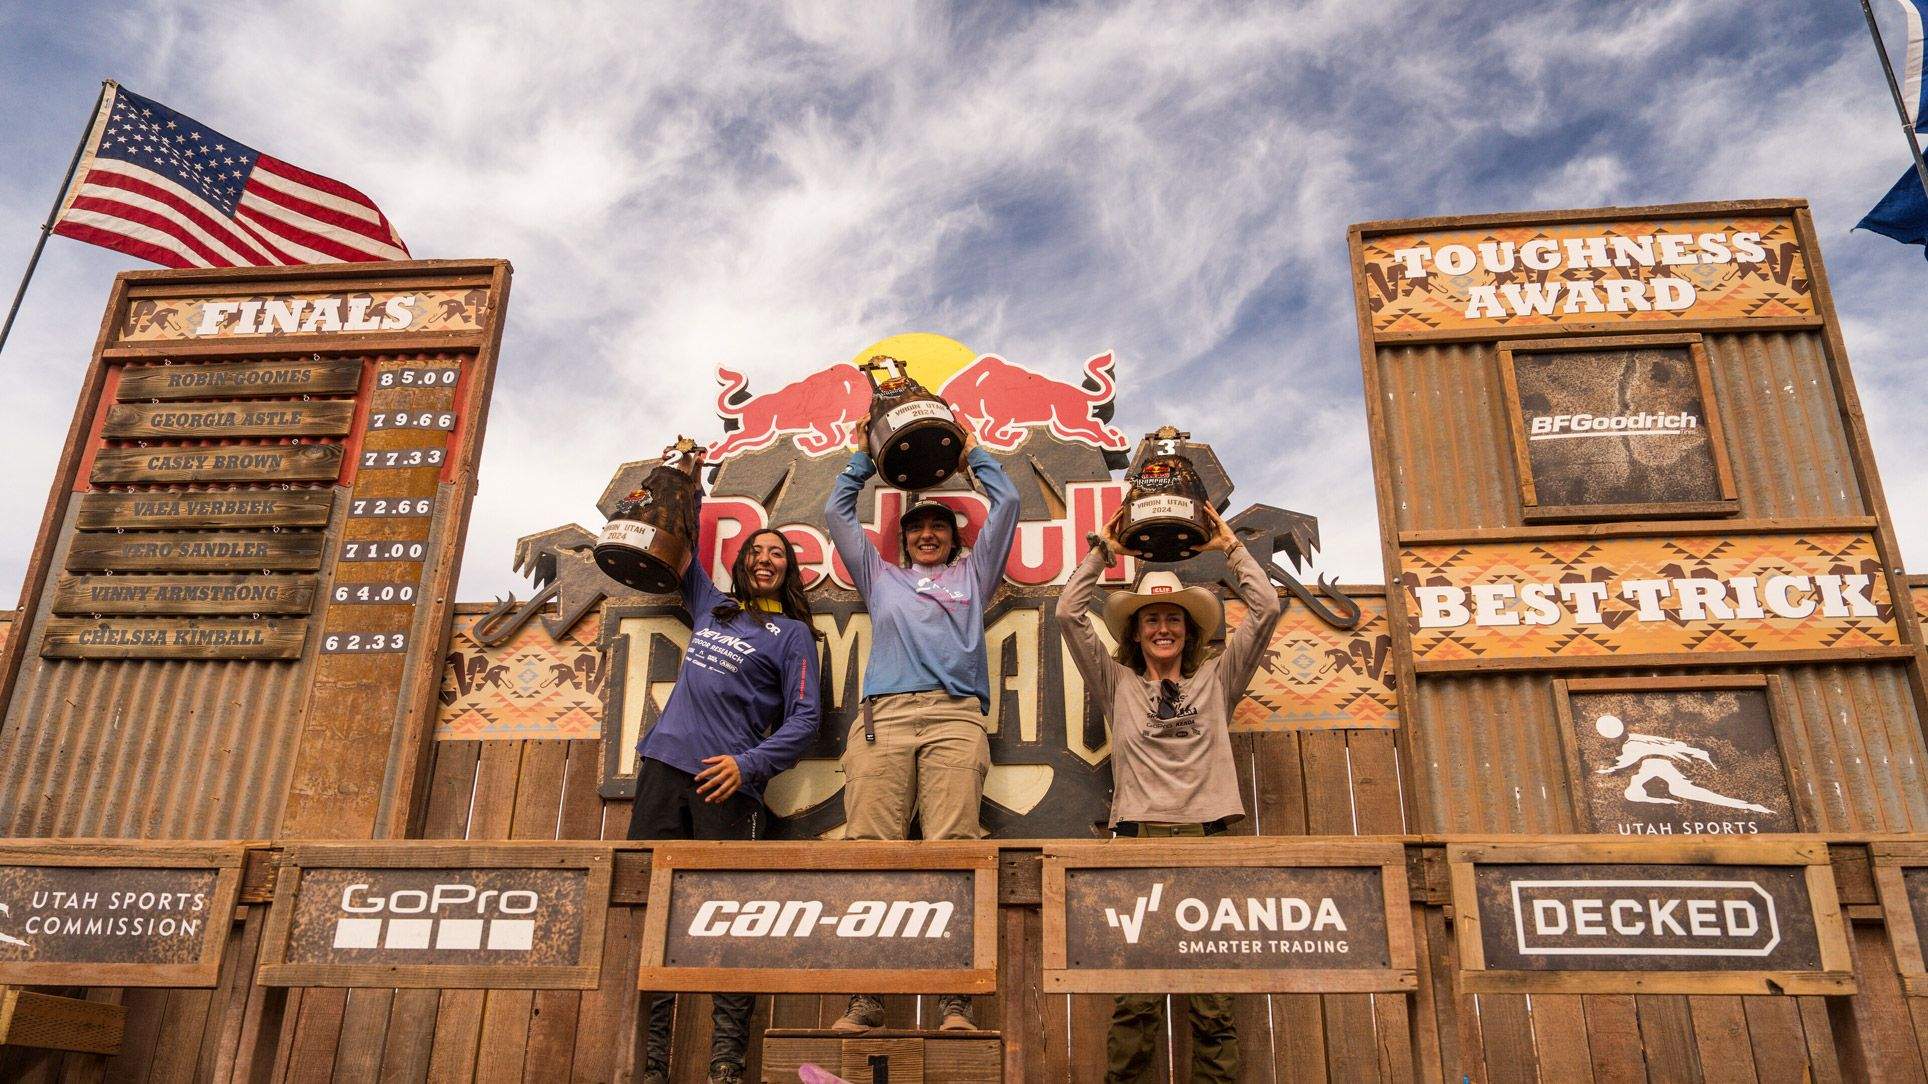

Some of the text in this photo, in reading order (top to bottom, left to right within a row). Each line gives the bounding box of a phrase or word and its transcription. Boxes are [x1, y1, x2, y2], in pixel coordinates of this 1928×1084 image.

[1394, 231, 1767, 280] TOUGHNESS
[1464, 276, 1697, 319] AWARD
[196, 295, 415, 335] FINALS
[168, 369, 311, 387] ROBIN GOOMES
[380, 371, 455, 386] 85.00
[151, 411, 302, 428] GEORGIA ASTLE
[374, 413, 451, 428] 79.66
[1531, 411, 1698, 434] BFGoodrich
[1157, 439, 1176, 455] 3
[148, 454, 283, 471] CASEY BROWN
[365, 450, 441, 466] 77.33
[663, 450, 684, 466] 2
[354, 500, 429, 515] 72.66
[1137, 499, 1188, 509] VIRGIN UTAH
[625, 524, 645, 534] UTAH
[122, 542, 268, 558] VERO SANDLER
[346, 543, 422, 558] 71.00
[91, 585, 278, 601] VINNY ARMSTRONG
[335, 586, 413, 601] 64.00
[1415, 574, 1878, 629] BEST TRICK
[79, 630, 264, 645] CHELSEA KIMBALL
[765, 622, 781, 636] OR
[325, 634, 404, 651] 62.33
[695, 628, 756, 655] DEVINCI
[711, 645, 744, 664] RESEARCH
[1618, 821, 1758, 836] UTAH SPORTS
[32, 891, 205, 911] UTAH SPORTS
[341, 884, 539, 914] GoPro
[688, 900, 949, 938] can-am
[1176, 897, 1347, 932] OANDA
[1532, 899, 1759, 936] DECKED
[25, 917, 197, 937] COMMISSION
[1178, 940, 1349, 954] SMARTER TRADING
